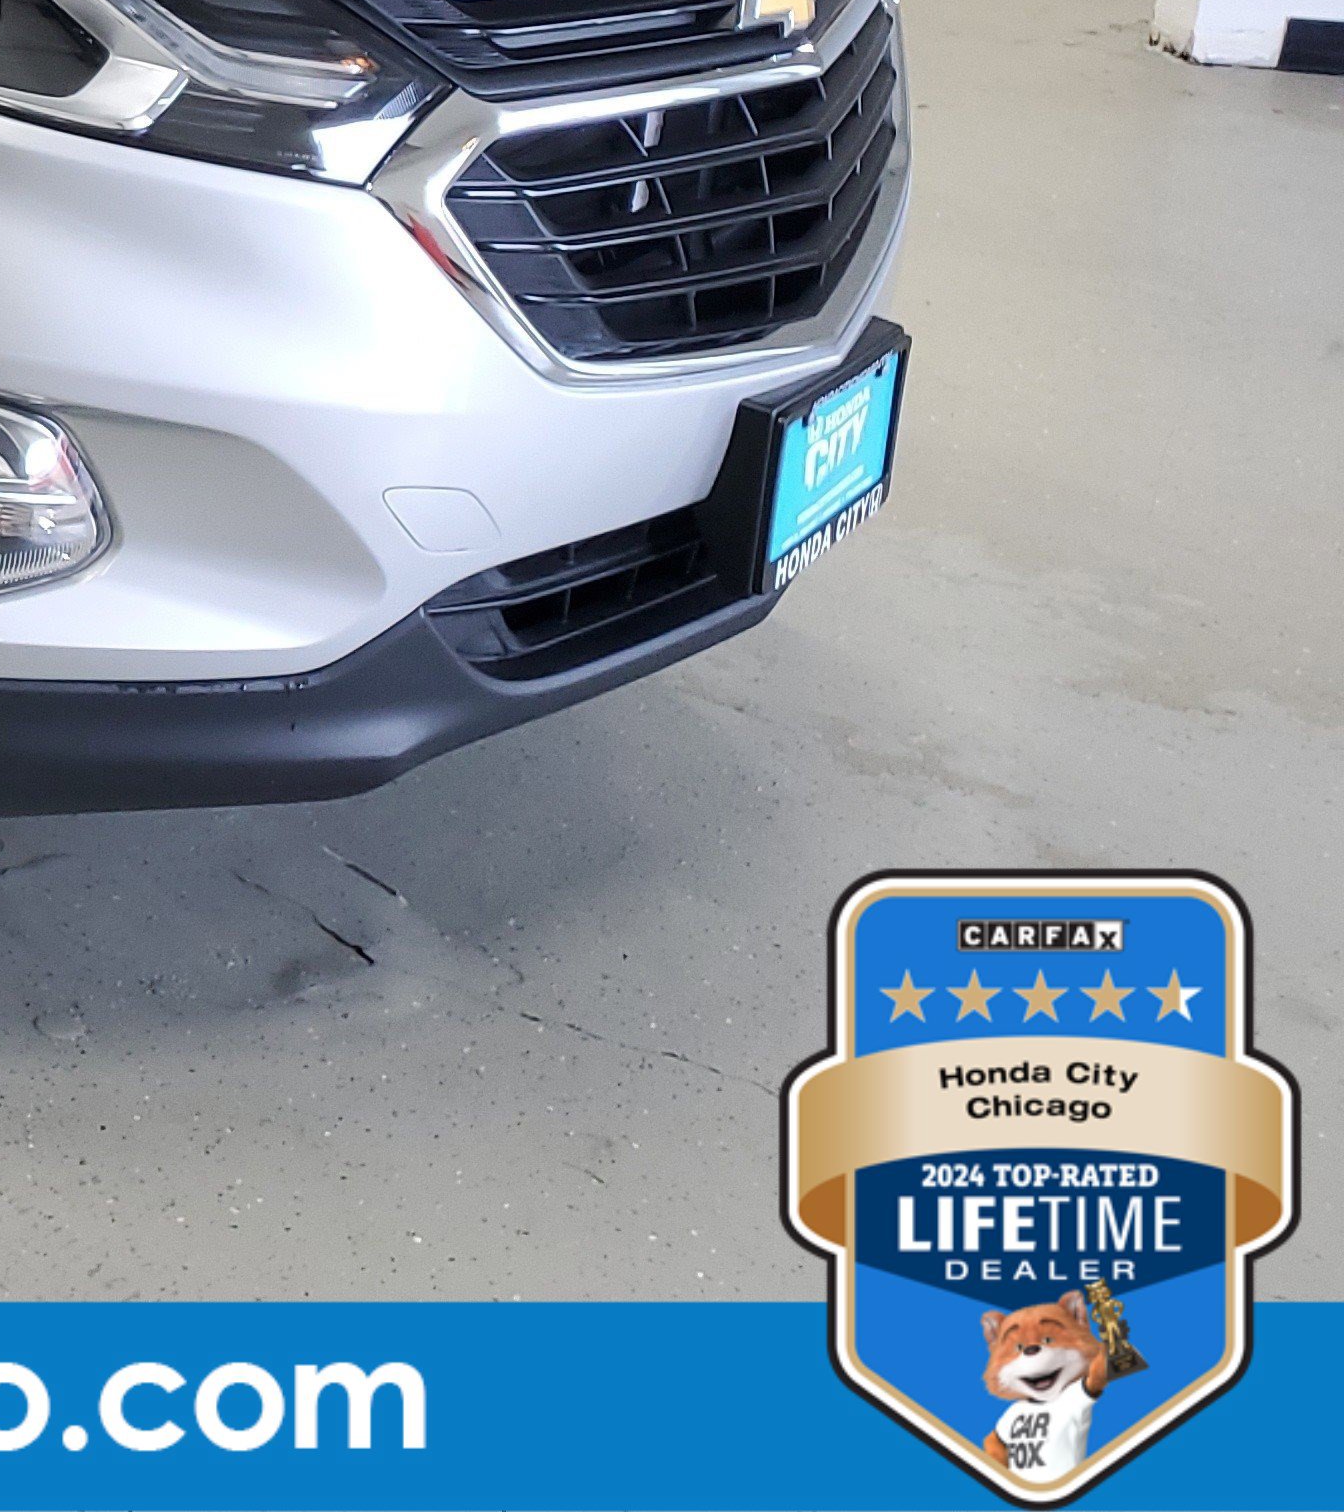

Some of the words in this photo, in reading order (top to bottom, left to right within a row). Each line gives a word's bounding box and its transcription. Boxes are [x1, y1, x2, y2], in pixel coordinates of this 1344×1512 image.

[804, 403, 870, 492] CITY
[824, 386, 871, 432] HONDA
[774, 529, 831, 589] HONDA
[835, 495, 874, 543] CITY
